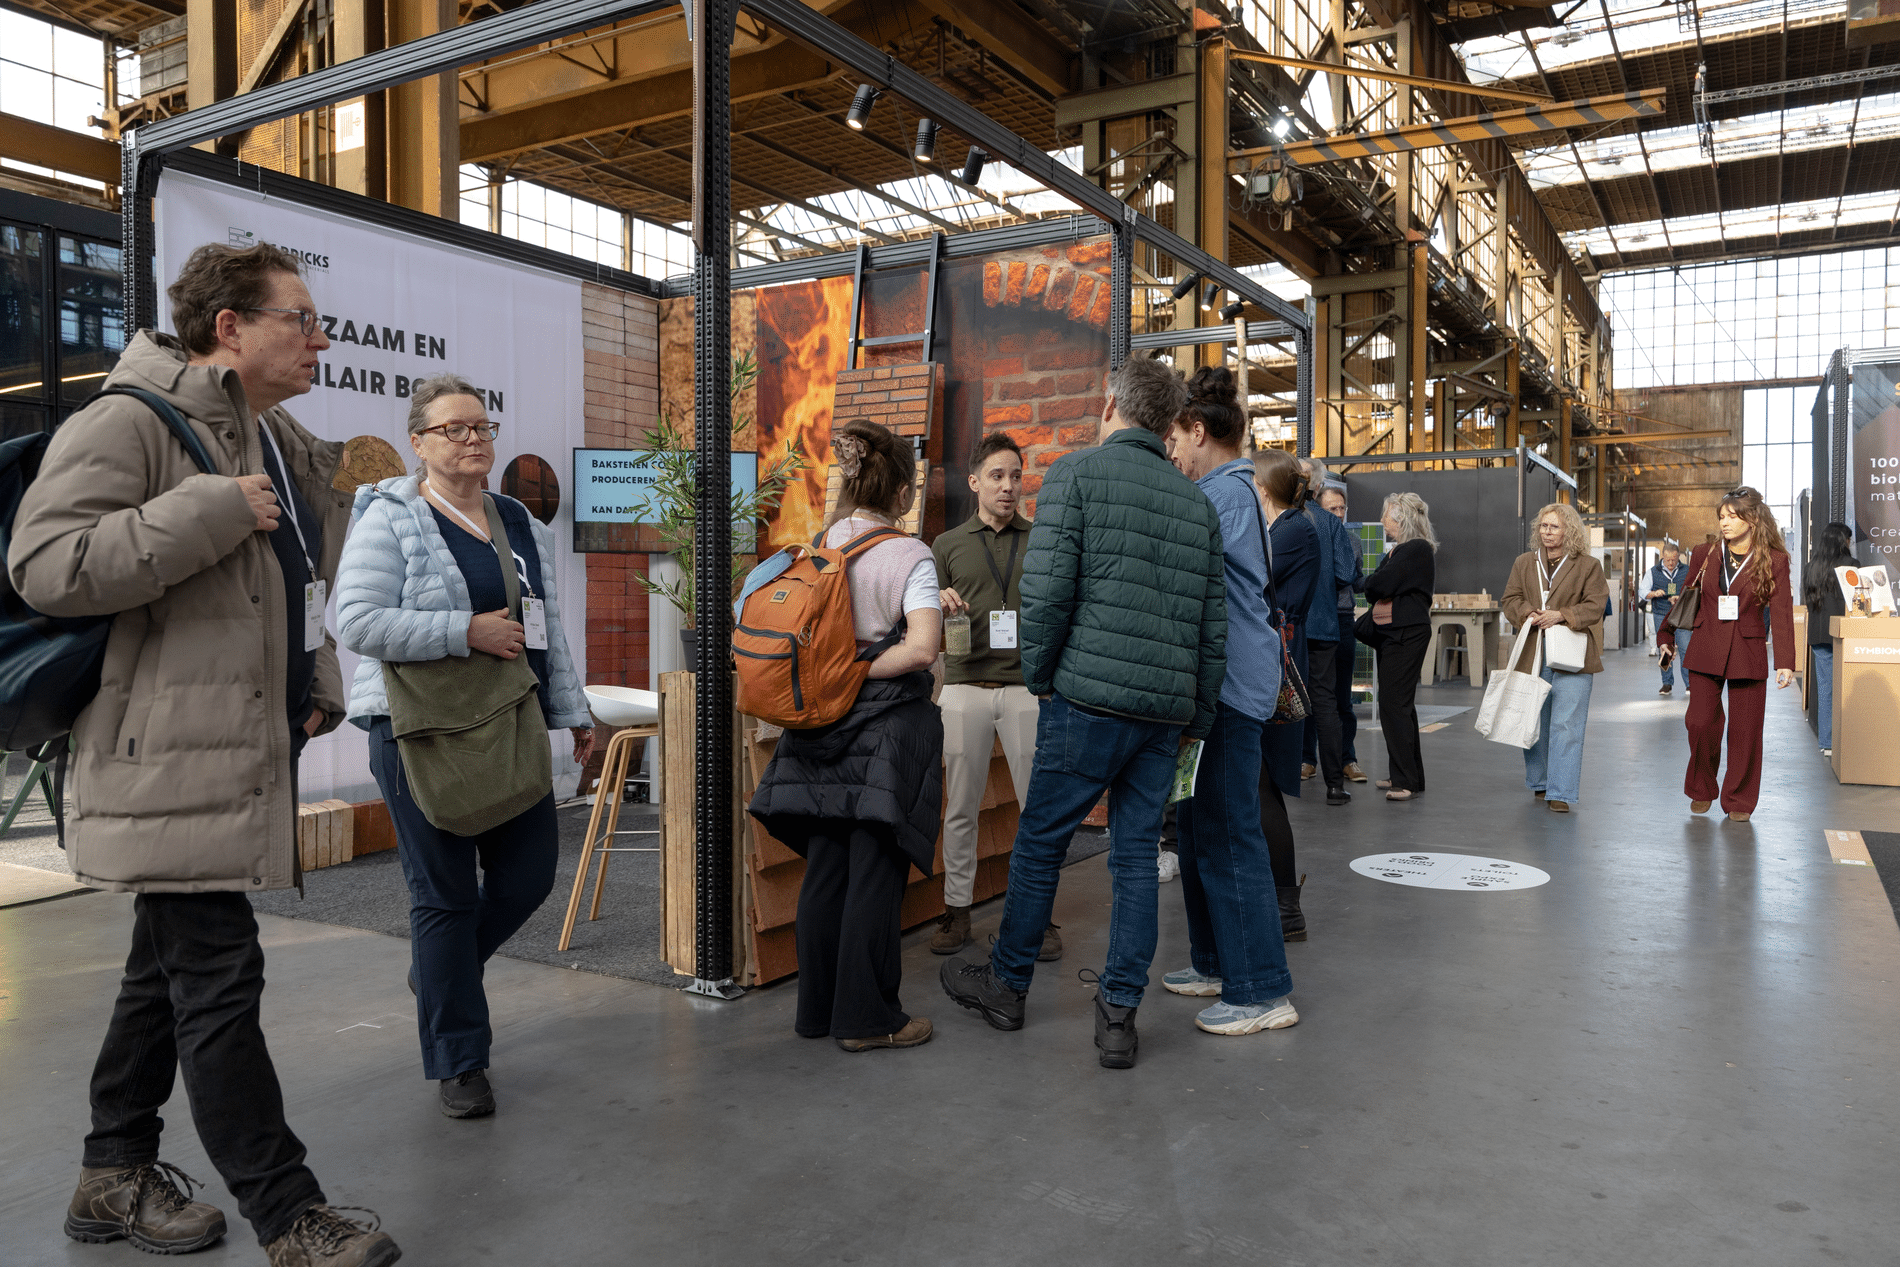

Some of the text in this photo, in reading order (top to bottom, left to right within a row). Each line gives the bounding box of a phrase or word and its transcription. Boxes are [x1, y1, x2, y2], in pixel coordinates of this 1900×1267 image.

[321, 314, 446, 360] ZAAM EN
[310, 362, 386, 396] ULAIR
[591, 475, 656, 485] PRODUCEREN
[1870, 472, 1900, 485] bio
[591, 505, 613, 514] KAN
